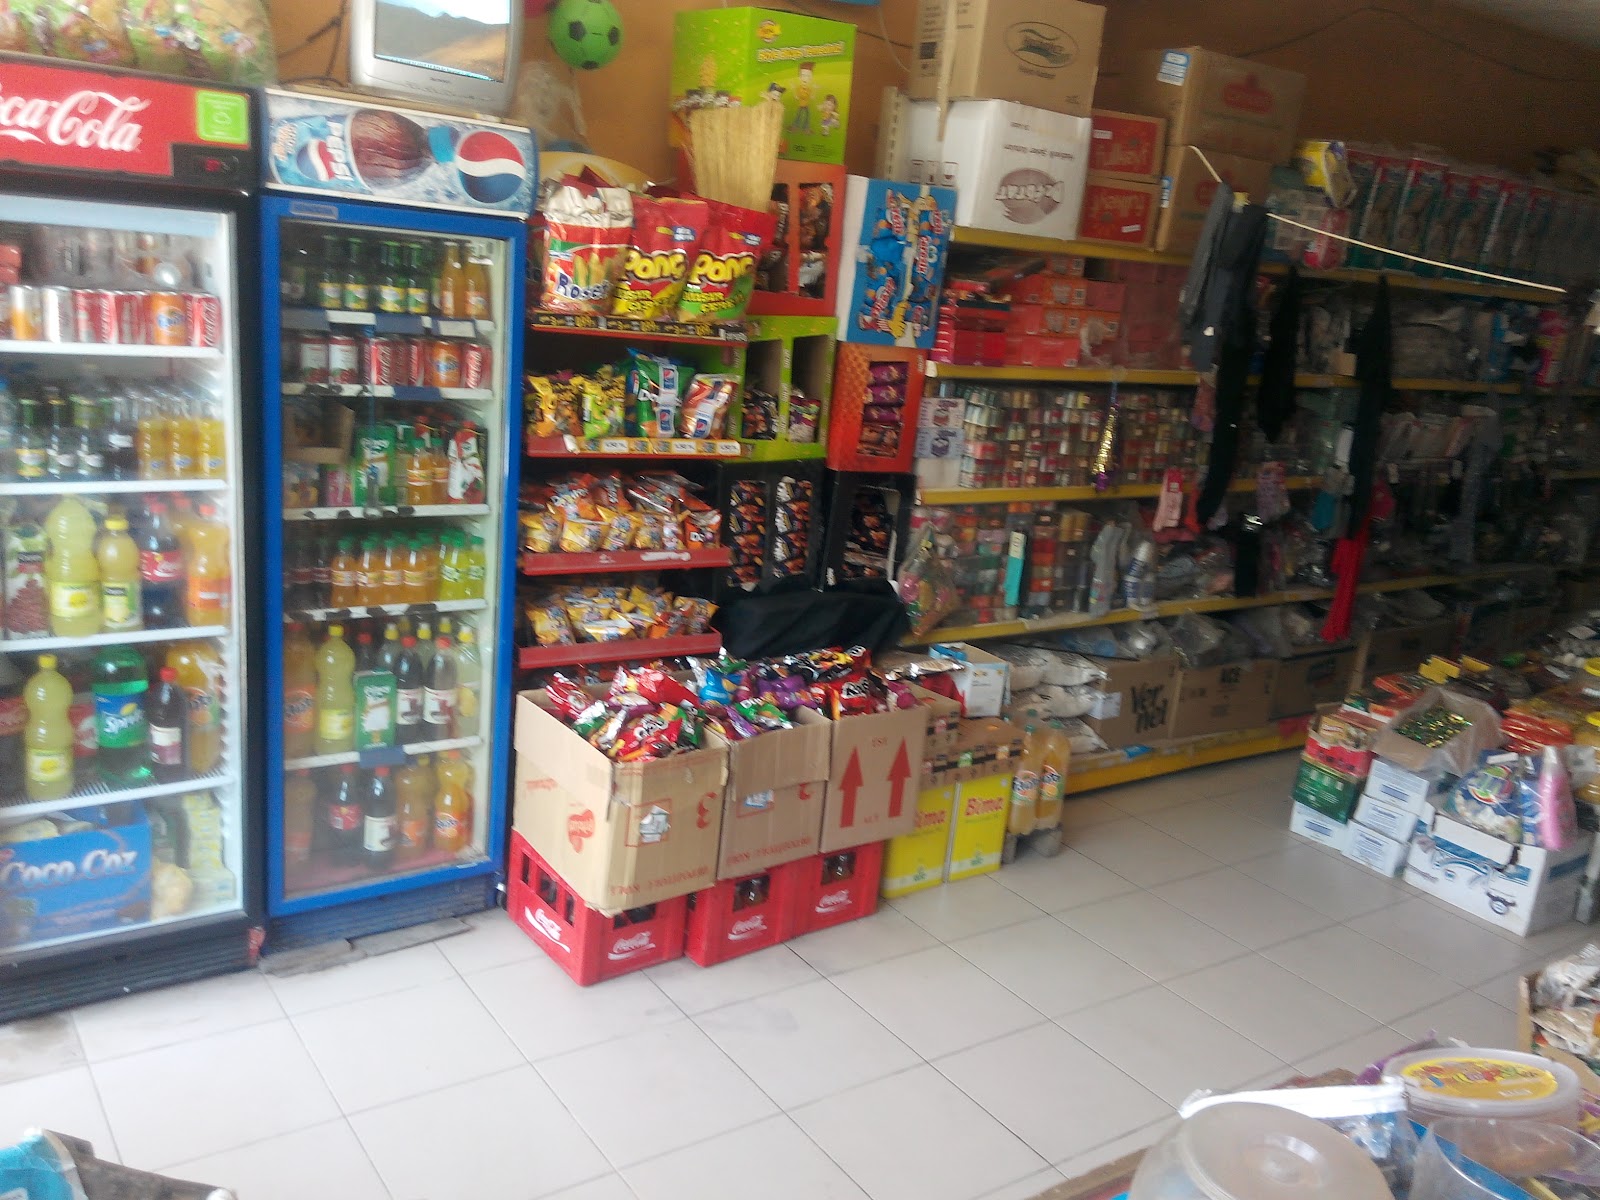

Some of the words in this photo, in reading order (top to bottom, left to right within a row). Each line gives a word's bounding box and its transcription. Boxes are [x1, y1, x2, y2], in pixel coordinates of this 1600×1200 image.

[0, 89, 153, 153] ca-Cola
[327, 120, 354, 182] PEPSI
[82, 849, 138, 879] Coz
